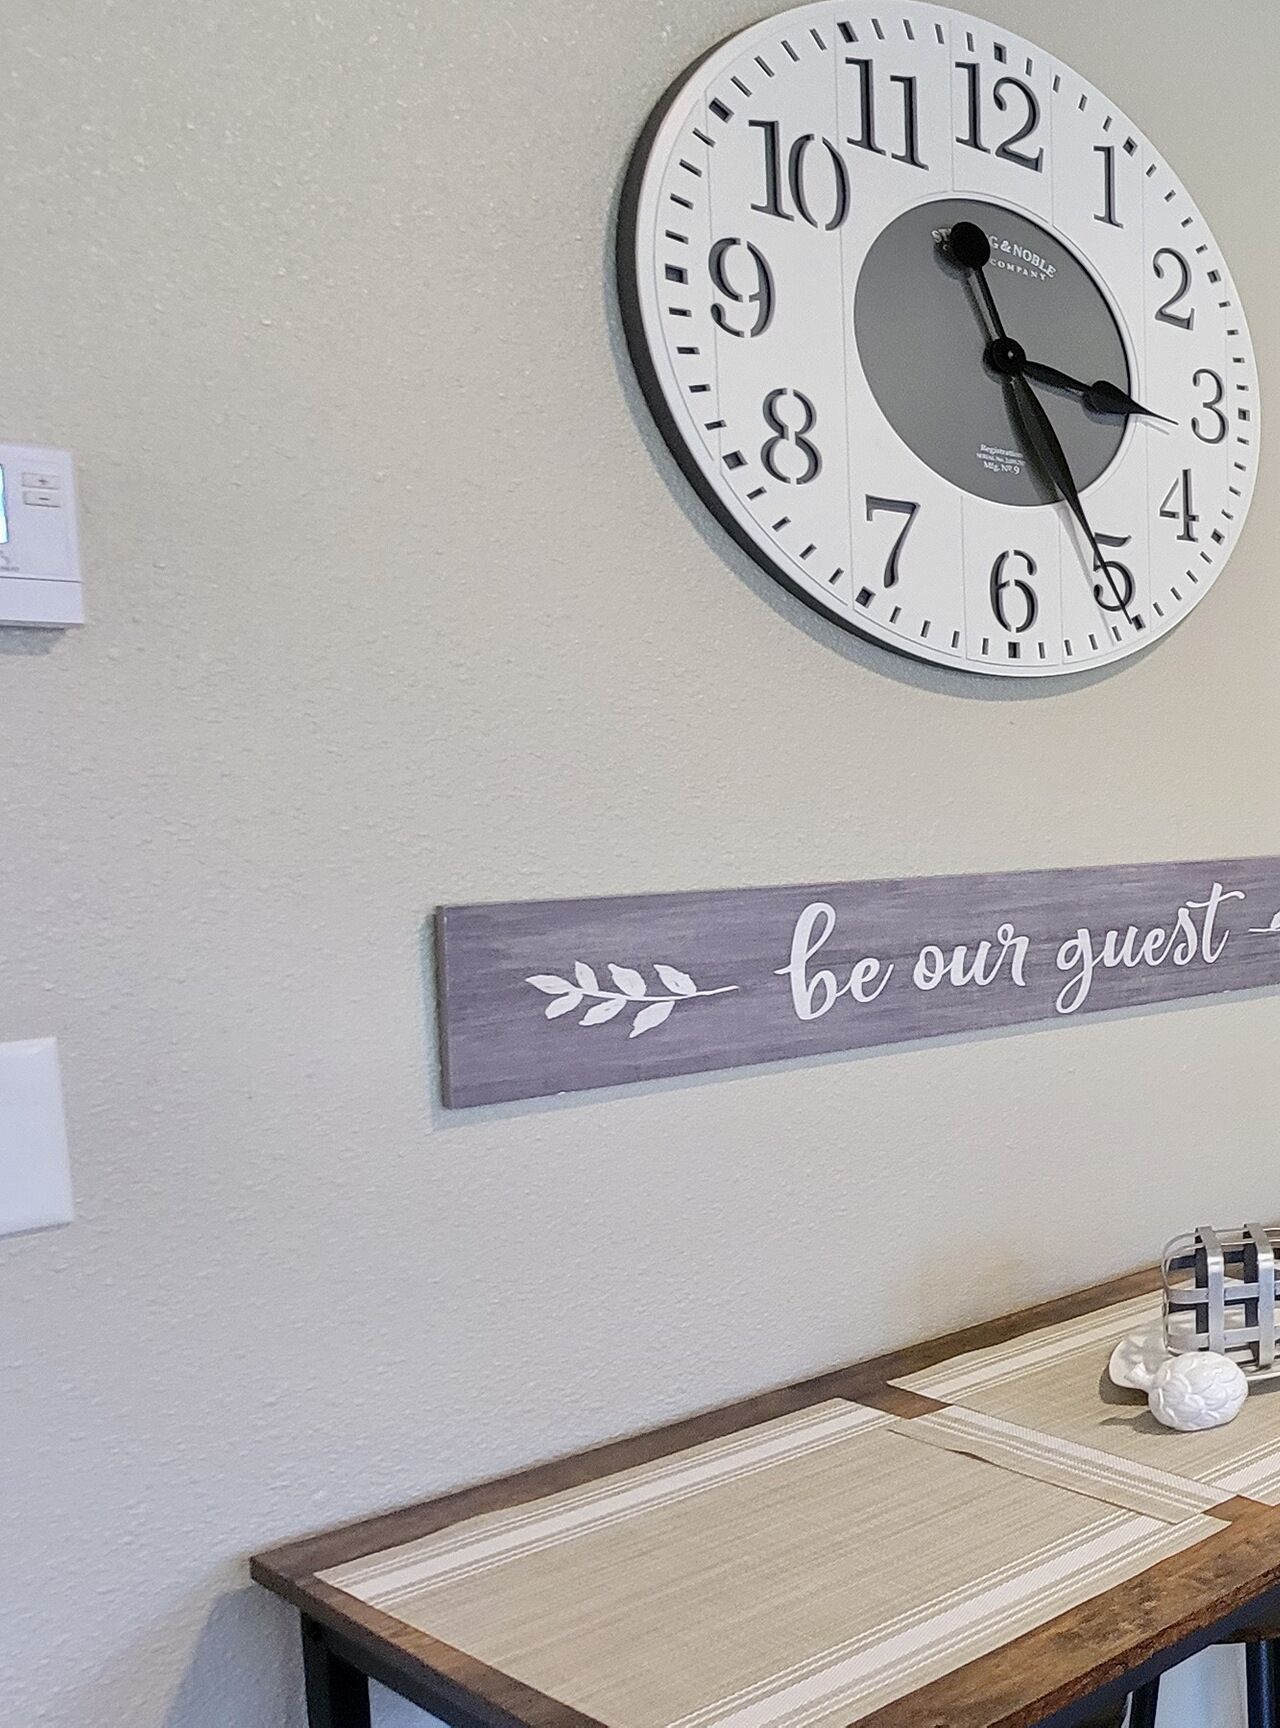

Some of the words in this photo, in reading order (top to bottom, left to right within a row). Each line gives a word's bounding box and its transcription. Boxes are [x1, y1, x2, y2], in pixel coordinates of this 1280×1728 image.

[845, 57, 929, 171] 11
[954, 61, 1044, 173] 12
[749, 119, 850, 231] 10
[1093, 144, 1124, 229] 1
[708, 237, 775, 337] 9
[989, 258, 1047, 280] COMPANY
[1152, 247, 1194, 330] 2
[760, 388, 822, 484] 8
[1191, 368, 1228, 444] 3
[865, 495, 920, 588] 7
[1159, 468, 1199, 542] 4
[989, 550, 1038, 633] 6
[1093, 532, 1134, 612] 5
[773, 901, 894, 1022] be
[914, 921, 1030, 990] our
[1055, 882, 1246, 1014] guest
